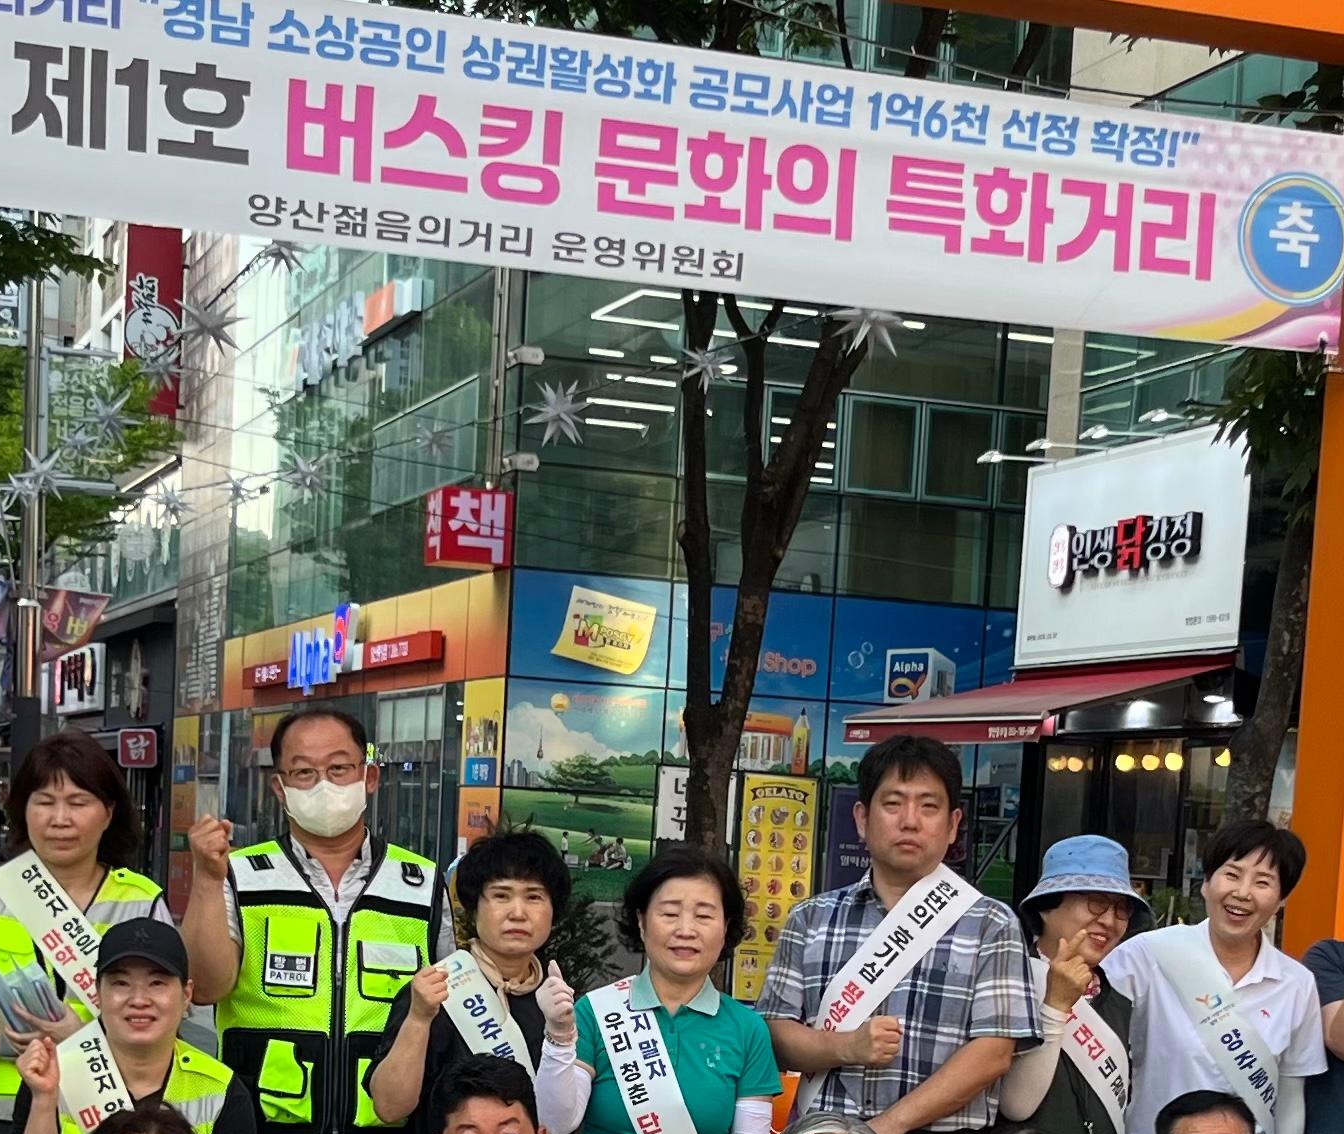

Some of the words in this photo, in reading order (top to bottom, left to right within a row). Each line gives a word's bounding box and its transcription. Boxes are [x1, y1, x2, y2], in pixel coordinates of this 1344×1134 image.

[268, 10, 447, 75] 소상공인
[462, 34, 677, 105] 상권활성화
[688, 64, 854, 129] 공모사업
[866, 91, 991, 148] 1억6천
[1001, 108, 1081, 157] 선정
[11, 41, 252, 166] 제1호
[286, 78, 564, 206] 버스킹
[594, 116, 858, 242] 문화의
[886, 154, 1216, 283] 특화거리
[247, 192, 534, 257] 양산젊음의거리
[550, 230, 745, 283] 운영위원회
[1269, 202, 1320, 269] 축
[448, 492, 505, 564] 책
[1071, 512, 1199, 571] 인생닭강정
[763, 652, 817, 678] Shop
[893, 661, 925, 674] Alpha
[755, 787, 805, 802] GELATO
[21, 863, 68, 919] 약하지
[908, 879, 959, 930] 한번의
[40, 928, 76, 967] 마약
[269, 970, 308, 982] PATROL
[858, 925, 914, 985] 호기심
[80, 1037, 117, 1094] 약하지
[604, 1012, 633, 1053] 우리
[620, 1061, 650, 1106] 청춘
[639, 1038, 667, 1079] 말자
